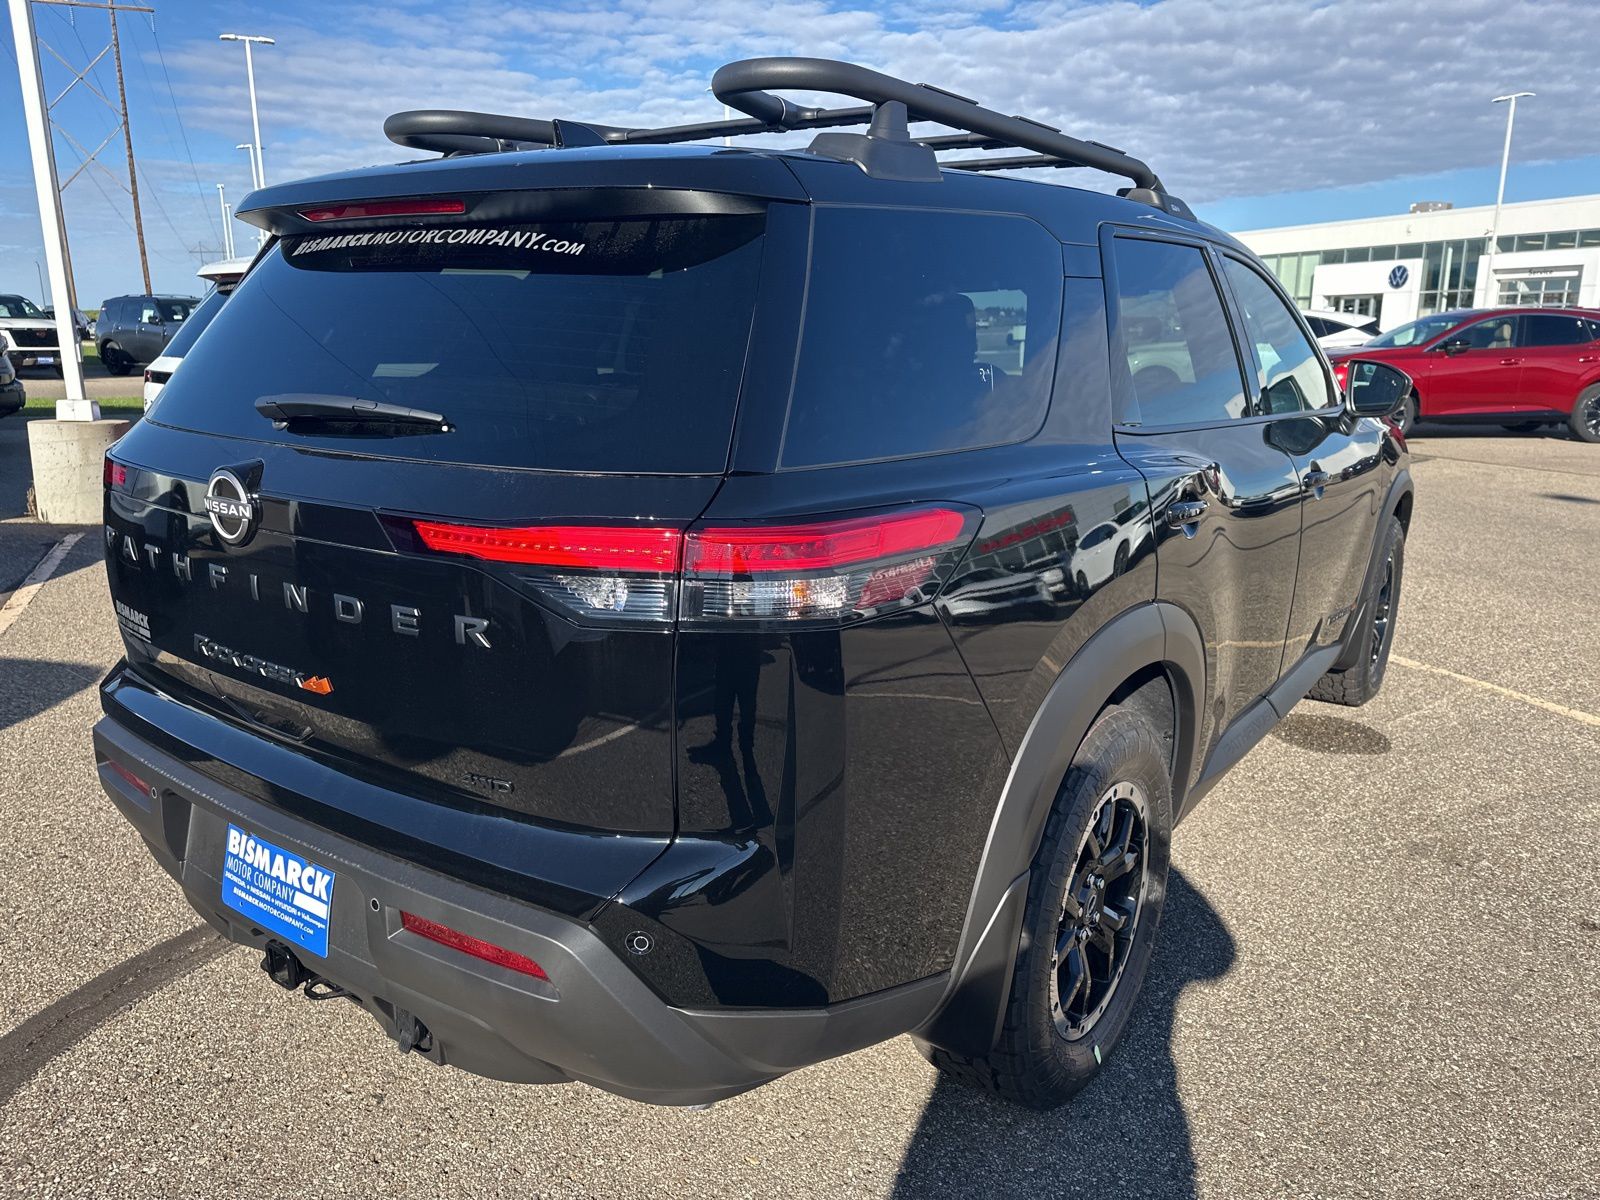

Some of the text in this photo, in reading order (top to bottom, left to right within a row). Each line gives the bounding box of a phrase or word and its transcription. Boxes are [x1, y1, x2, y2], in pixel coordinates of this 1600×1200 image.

[292, 228, 585, 257] BISMARCKMOTORCOMPANY.COM
[204, 497, 250, 518] NISSAN
[105, 524, 492, 650] PATHFINDER
[226, 855, 295, 905] MOTOR COMPANY
[227, 828, 331, 902] BISMARCK
